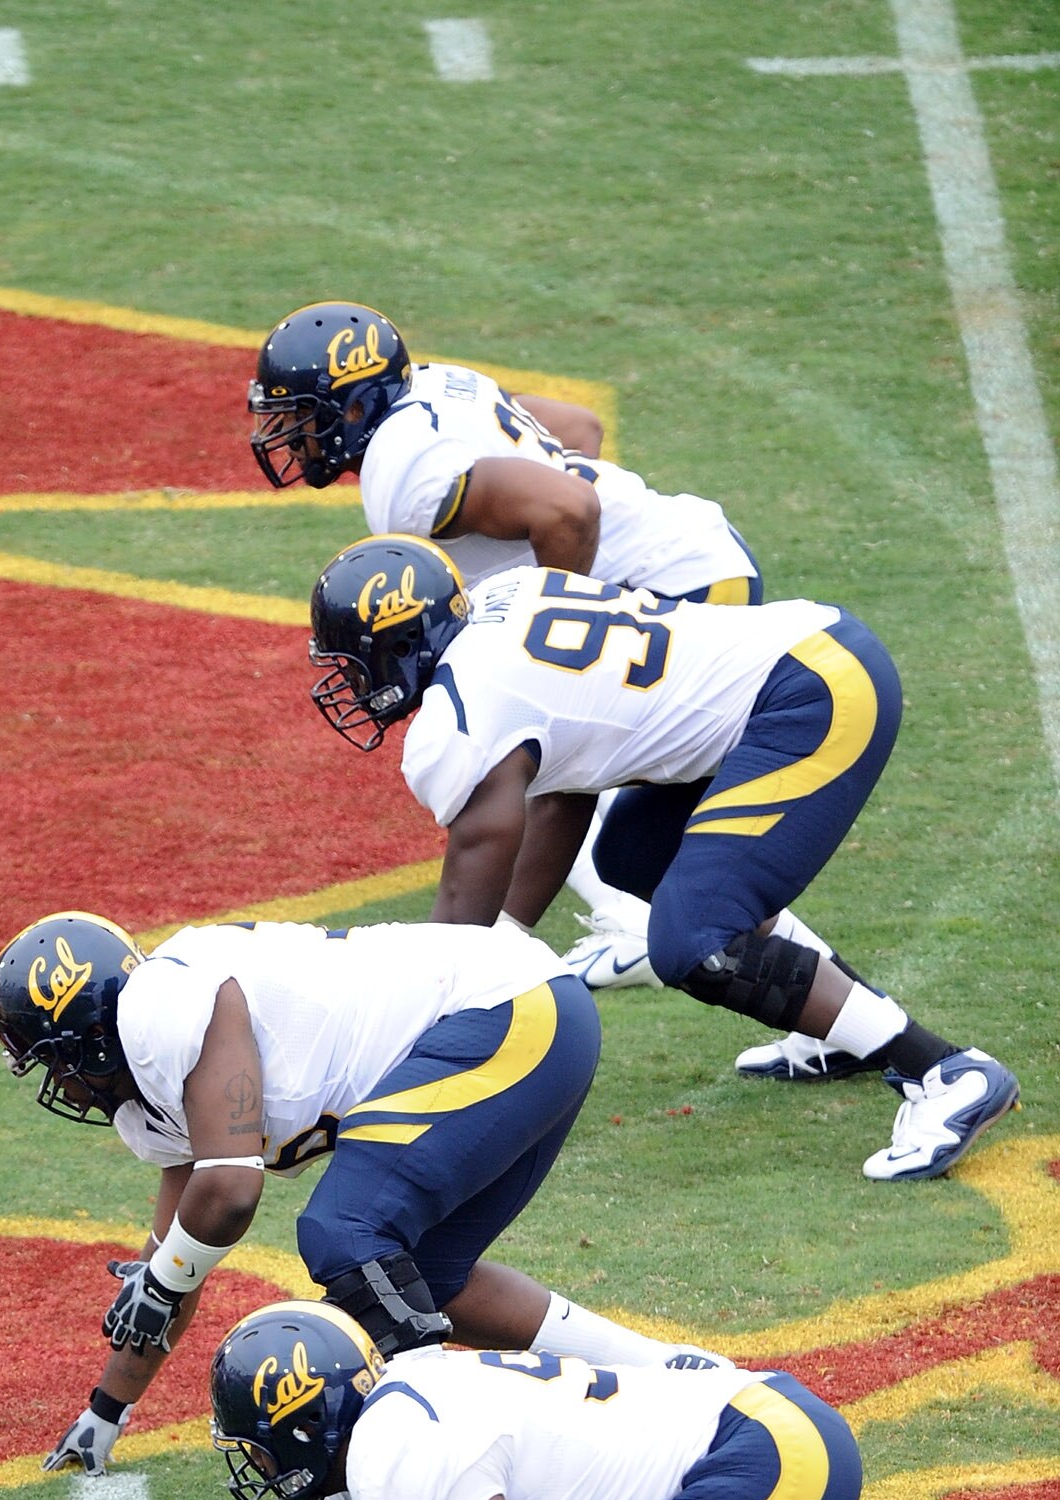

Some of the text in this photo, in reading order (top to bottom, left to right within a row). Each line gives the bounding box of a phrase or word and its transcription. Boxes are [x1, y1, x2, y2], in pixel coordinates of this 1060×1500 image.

[327, 323, 389, 390] Cal
[357, 563, 427, 633] Cal
[522, 566, 680, 693] 95
[27, 936, 93, 1022] Cal
[253, 1340, 326, 1427] Cal
